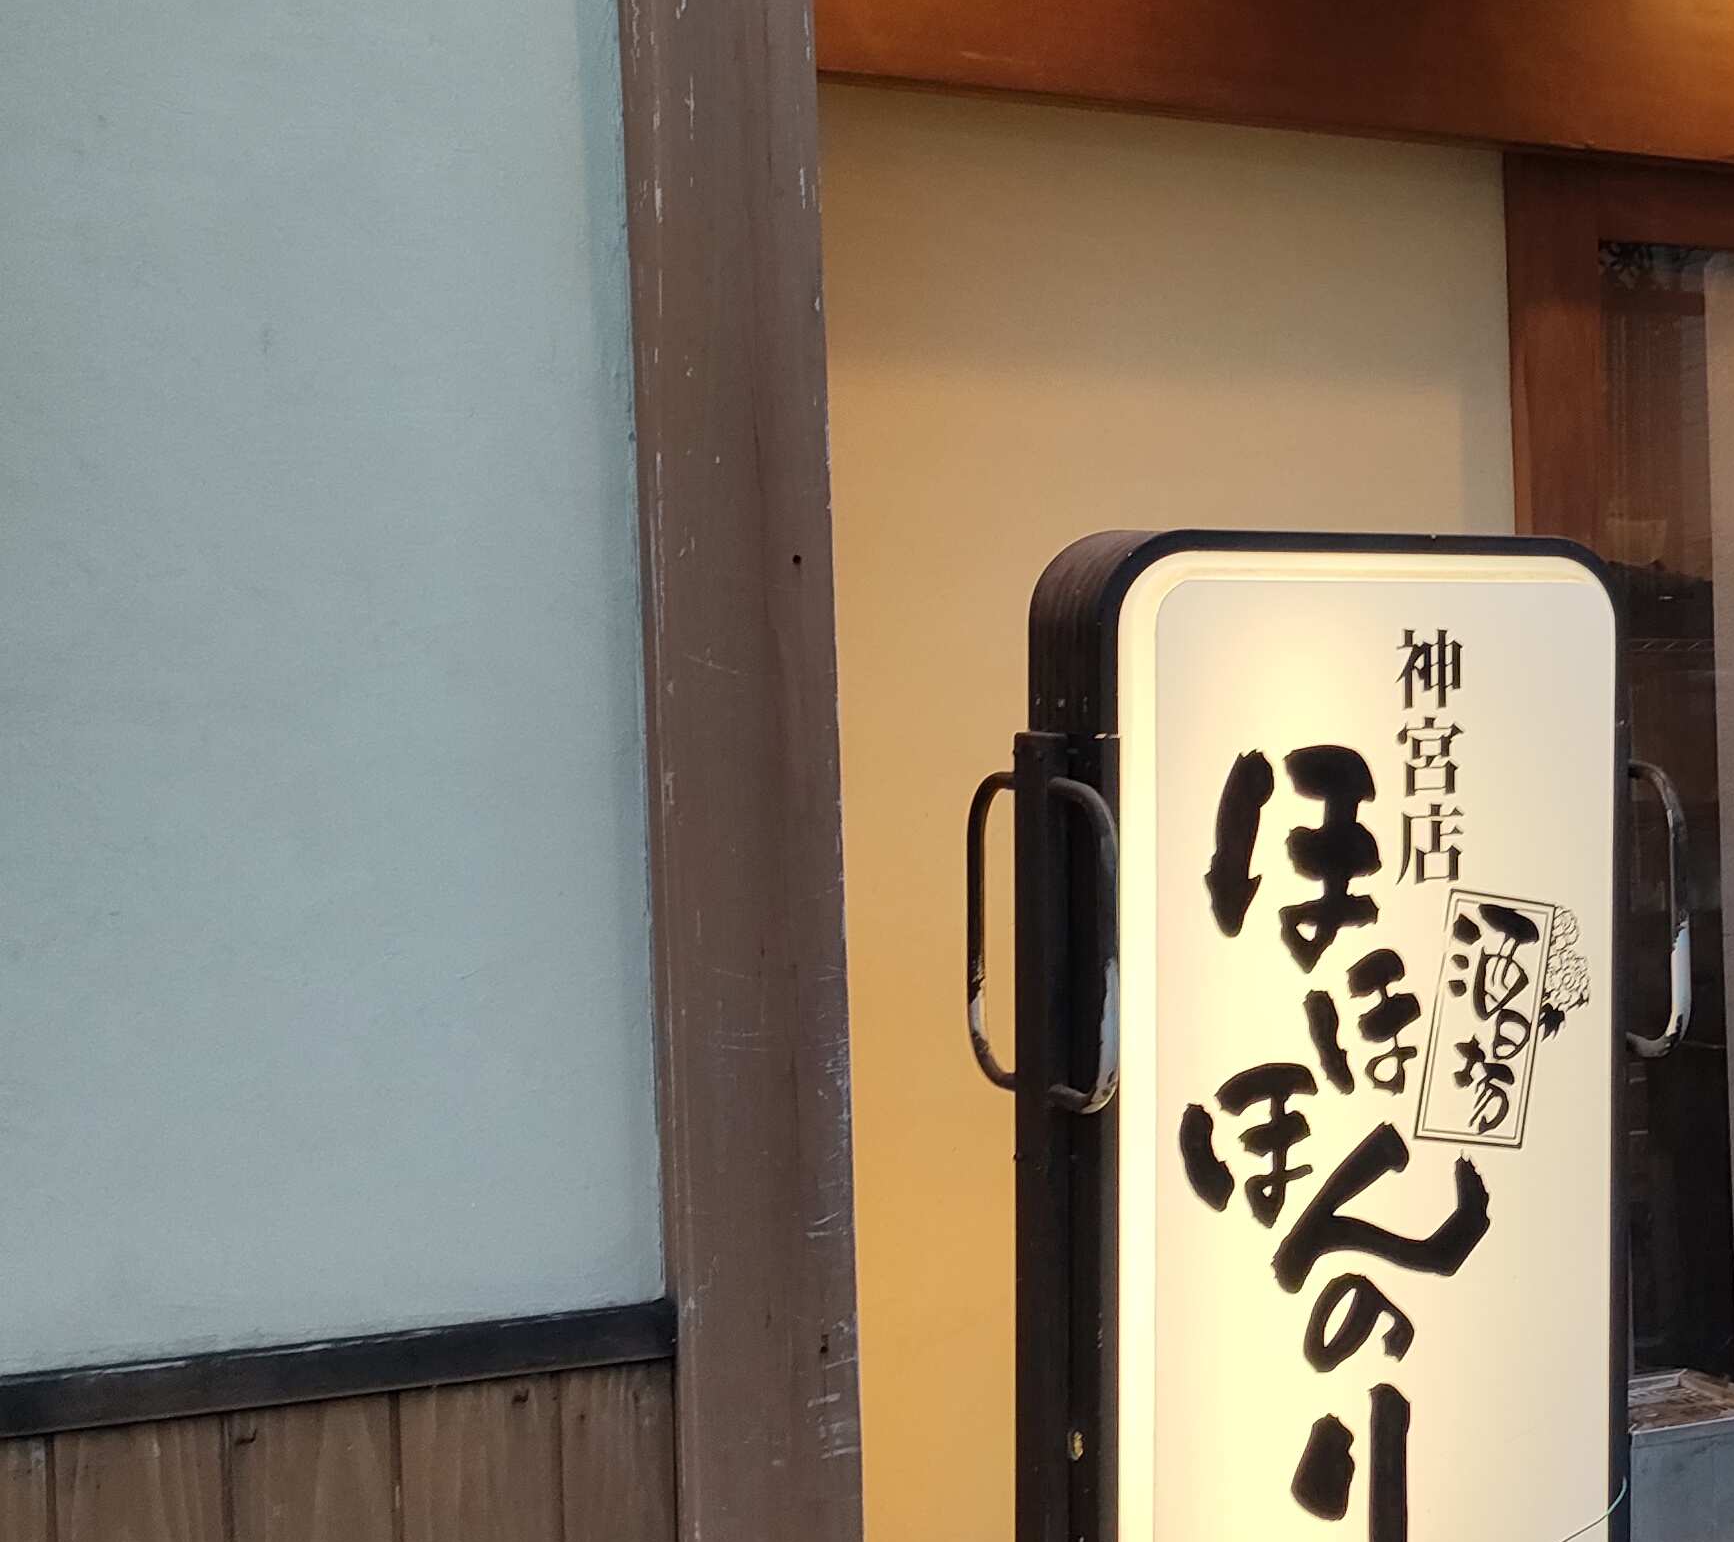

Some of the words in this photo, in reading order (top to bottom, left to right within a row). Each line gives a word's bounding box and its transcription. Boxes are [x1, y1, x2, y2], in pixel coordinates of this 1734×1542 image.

[1395, 629, 1464, 886] 神宮店
[1450, 902, 1540, 1135] 酒場
